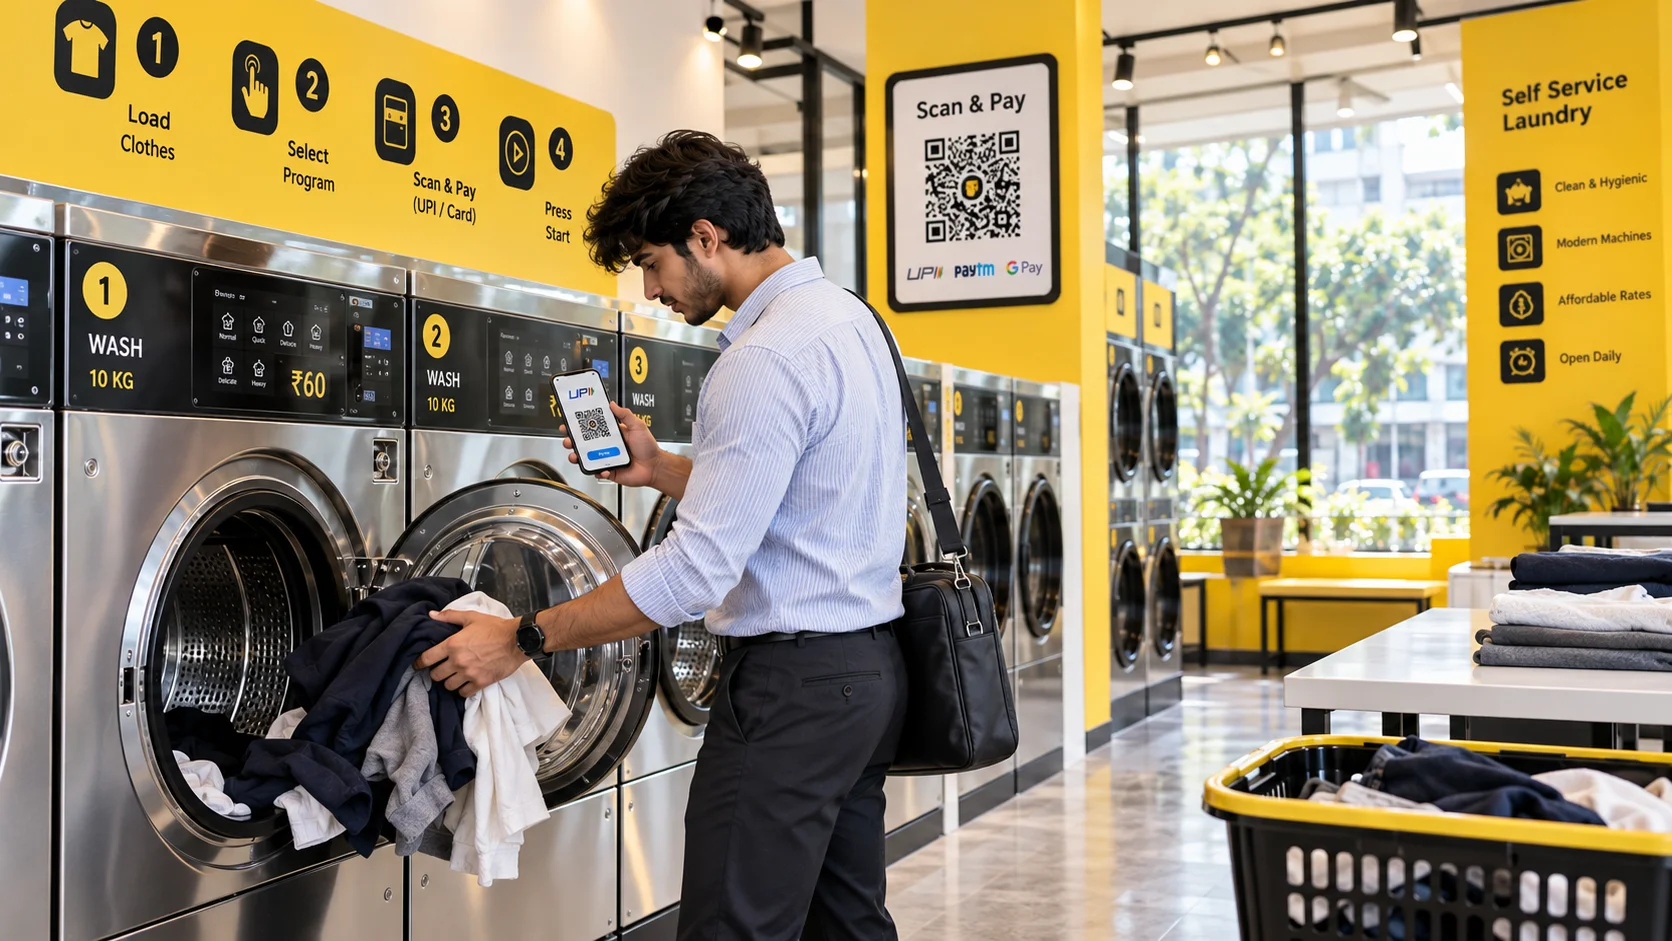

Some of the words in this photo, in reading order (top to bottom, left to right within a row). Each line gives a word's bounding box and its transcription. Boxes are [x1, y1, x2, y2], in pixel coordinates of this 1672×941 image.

[152, 31, 163, 64] 1
[306, 70, 319, 101] 2
[1502, 83, 1540, 106] Self
[1547, 72, 1628, 100] Service
[128, 103, 171, 131] Load
[916, 101, 963, 120] Scan
[969, 94, 984, 114] &
[990, 92, 1026, 114] Pay
[440, 105, 451, 132] 3
[1503, 107, 1592, 131] Laundry
[120, 133, 175, 161] Clothes
[287, 140, 329, 166] Select
[555, 137, 566, 161] 4
[284, 167, 334, 192] Program
[414, 172, 440, 191] Scan
[443, 177, 453, 194] &
[456, 181, 476, 201] Pay
[1554, 181, 1586, 193] Clean
[1588, 178, 1597, 189] &
[1599, 172, 1648, 190] Hygienic
[414, 196, 436, 215] (UPI
[438, 201, 445, 218] /
[448, 202, 477, 225] Card)
[545, 201, 572, 221] Press
[545, 225, 571, 244] Start
[1556, 236, 1598, 249] Modern
[1600, 231, 1652, 245] Machines
[906, 266, 943, 281] UPI
[954, 263, 994, 278] paytm
[1006, 260, 1019, 276] G
[1021, 260, 1043, 276] Pay
[99, 276, 110, 306] 1
[1558, 291, 1617, 306] Affordable
[1619, 290, 1652, 301] Rates
[88, 333, 143, 359] WASH
[431, 324, 442, 348] 2
[635, 355, 643, 376] 3
[1559, 352, 1591, 366] Open
[1593, 349, 1622, 364] Daily
[89, 368, 108, 388] 10
[112, 370, 134, 390] KG
[291, 369, 326, 399] ₹60
[426, 369, 460, 388] WASH
[427, 396, 439, 412] 10
[441, 397, 455, 413] KG
[632, 392, 655, 407] WASH
